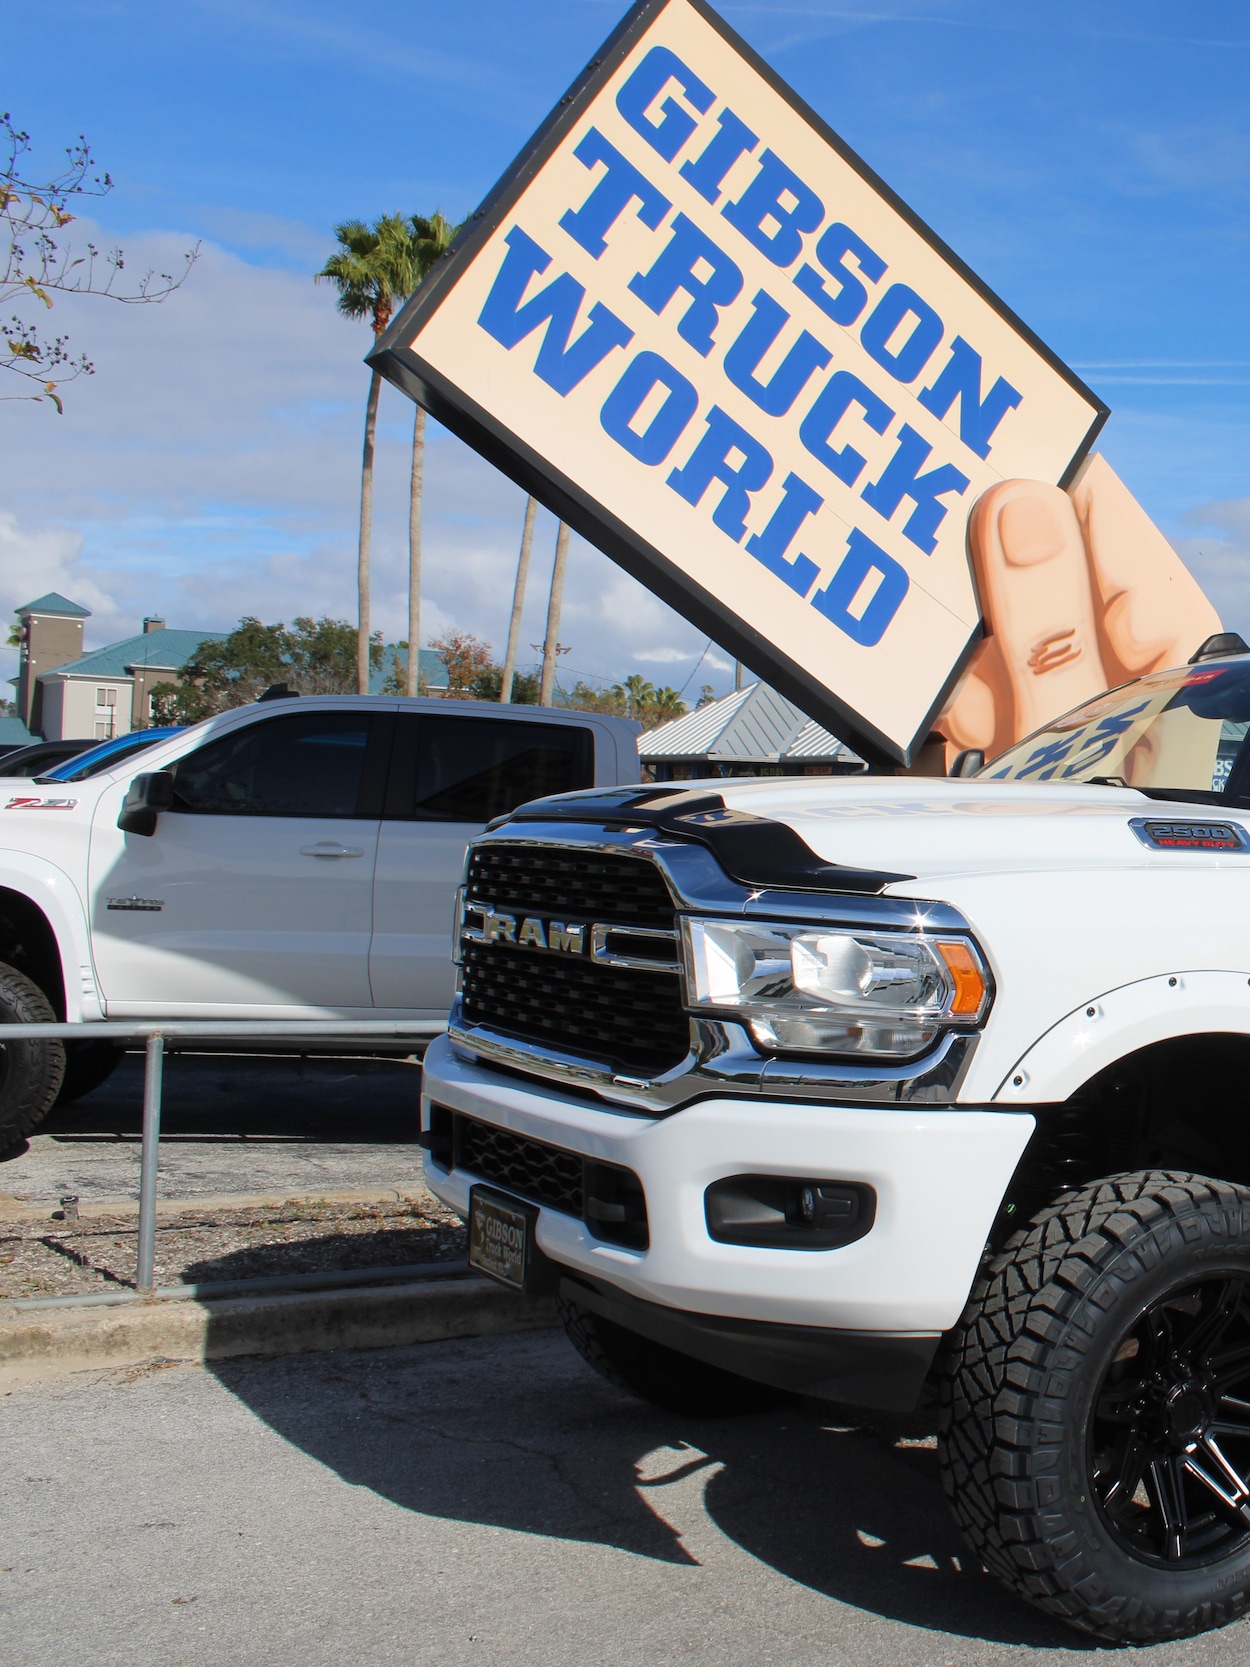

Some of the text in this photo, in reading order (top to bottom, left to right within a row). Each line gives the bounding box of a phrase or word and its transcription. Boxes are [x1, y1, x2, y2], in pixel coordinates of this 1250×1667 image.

[614, 45, 1023, 461] GIBSON
[557, 126, 970, 556] TRUCK
[476, 225, 910, 648] WORLD
[1150, 825, 1231, 839] 2500
[1158, 839, 1235, 848] HEAVY DUTY
[488, 912, 584, 954] RAM
[485, 1215, 524, 1250] GIBSON
